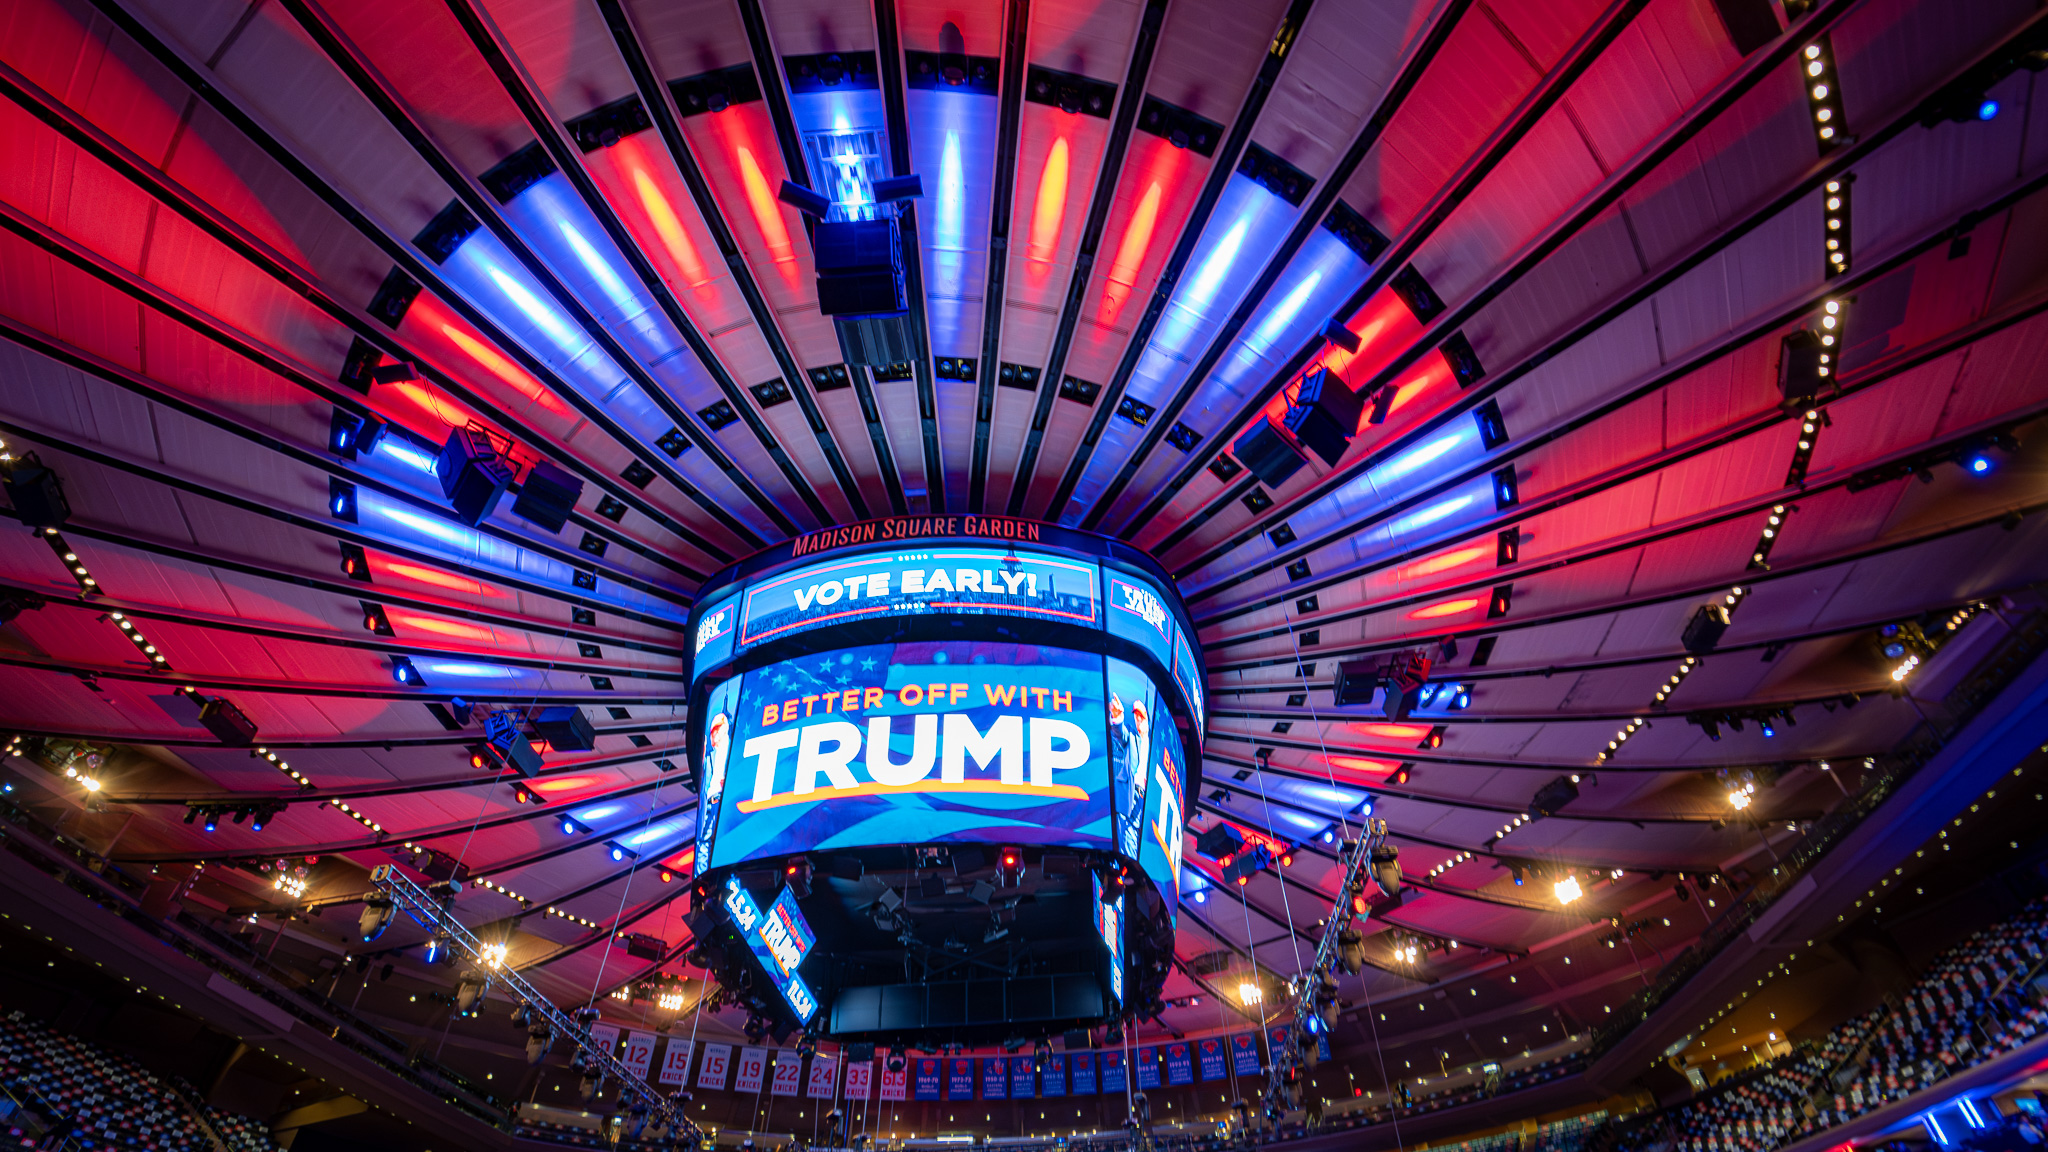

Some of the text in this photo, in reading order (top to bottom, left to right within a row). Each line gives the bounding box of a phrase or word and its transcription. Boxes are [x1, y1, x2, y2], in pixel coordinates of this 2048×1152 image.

[792, 516, 1040, 557] MADISON SQUARE GARDEN
[793, 568, 1037, 612] VOTE EARLY!
[761, 683, 1073, 727] BETTER OFF WITH
[743, 714, 1091, 803] TRUMP
[761, 909, 801, 971] TRUMP
[628, 1045, 648, 1064] 12
[668, 1052, 688, 1070] 15
[625, 1065, 647, 1077] NICKS
[705, 1056, 725, 1074] 15
[742, 1060, 761, 1078] 19
[776, 1064, 799, 1082] 22
[662, 1071, 686, 1082] KNICK
[700, 1076, 724, 1087] KNICKS
[737, 1079, 761, 1090] KNICKS
[811, 1067, 832, 1084] 24
[848, 1069, 869, 1085] 33
[883, 1070, 906, 1086] 613
[774, 1083, 797, 1093] KNICKS
[847, 1088, 868, 1096] KNICK
